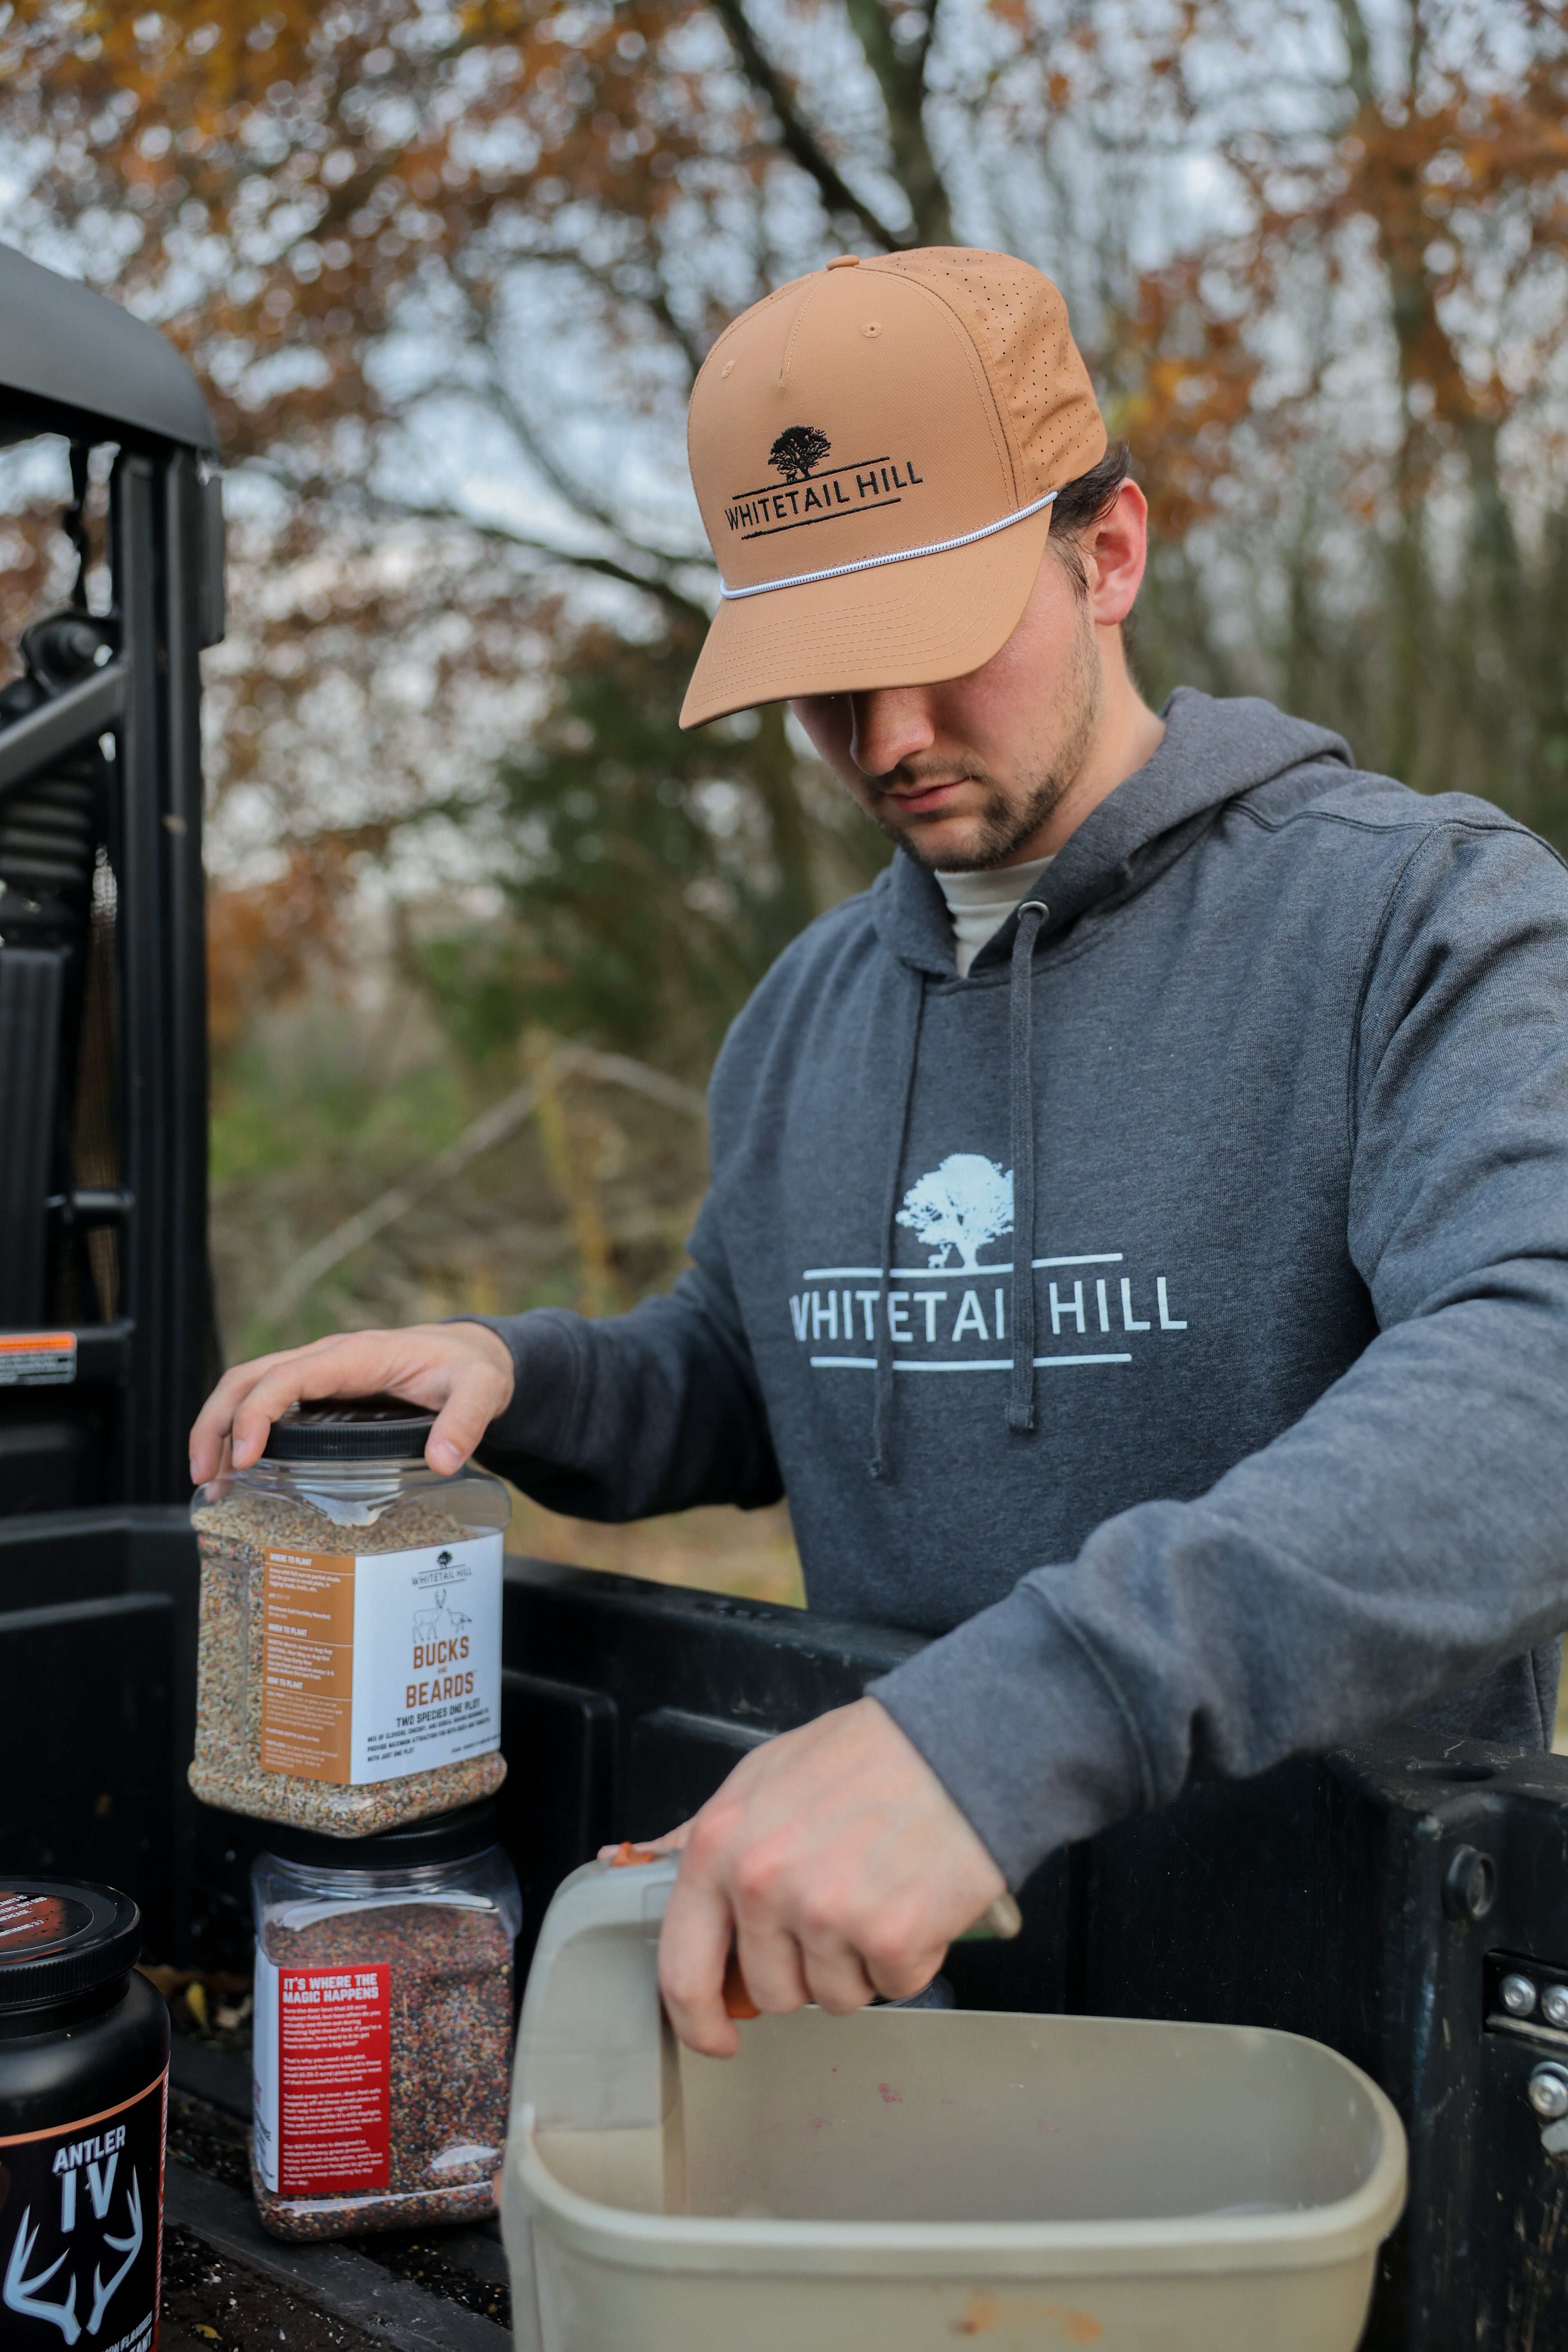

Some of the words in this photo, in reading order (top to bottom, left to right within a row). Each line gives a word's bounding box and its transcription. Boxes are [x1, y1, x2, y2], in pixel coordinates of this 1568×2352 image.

[725, 481, 850, 530] WHITETAIL
[856, 461, 923, 498] HILL
[789, 1287, 1005, 1342] WHITETAI
[1049, 1276, 1187, 1334] HILL
[288, 1555, 295, 1564] TO
[295, 1556, 312, 1566] PLANT
[412, 1570, 454, 1585] WHITETAIL
[457, 1567, 472, 1577] HILL
[291, 1626, 307, 1637] PLANT
[414, 1635, 469, 1669] BUCKS
[279, 1678, 286, 1686] TO
[287, 1679, 303, 1689] PLANT
[407, 1671, 474, 1708] BEARDS
[396, 1715, 414, 1727] TWO
[417, 1707, 448, 1723] SPECIES
[450, 1703, 462, 1715] ONE
[465, 1697, 480, 1710] PLOT
[283, 1976, 306, 1991] IT'S
[309, 1975, 352, 1990] WHERE
[354, 1973, 377, 1987] THE
[283, 1990, 321, 2004] MAGIC
[323, 1986, 379, 2003] HAPPENS
[53, 2125, 125, 2173] ANTLER
[61, 2152, 119, 2233] IV
